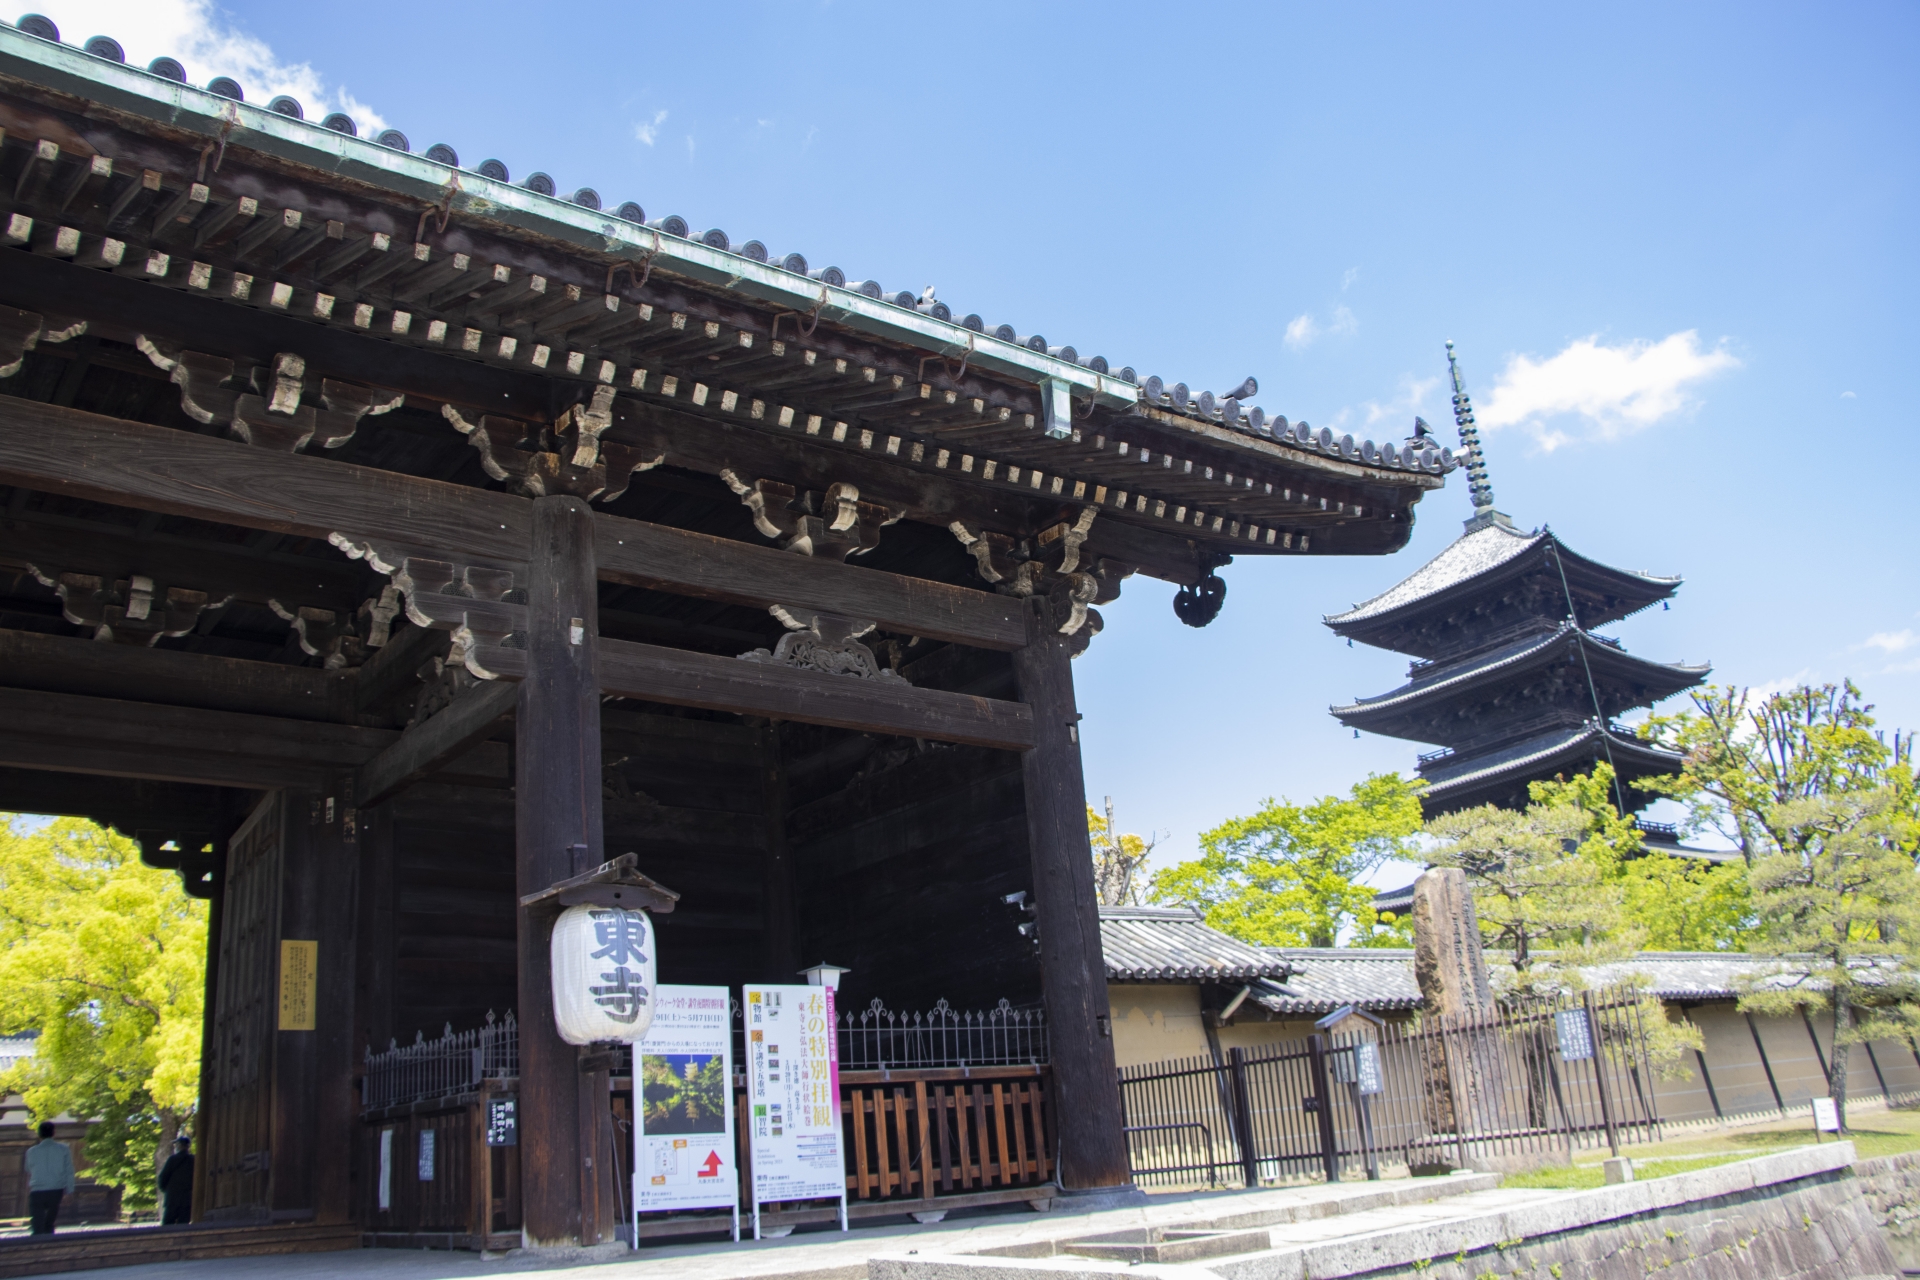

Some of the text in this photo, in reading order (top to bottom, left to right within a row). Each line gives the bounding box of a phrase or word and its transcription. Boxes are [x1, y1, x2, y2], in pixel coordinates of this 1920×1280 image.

[588, 907, 648, 1024] 東寺
[653, 1013, 723, 1023] 9日(土)〜5月7日(日)
[752, 993, 762, 1023] 宝物館
[755, 1032, 766, 1098] 金堂・講堂・五重塔
[798, 1002, 811, 1127] 東寺と弘法大師行状絵巻
[807, 993, 831, 1127] 春の特別拝観
[758, 1106, 767, 1137] 観智院
